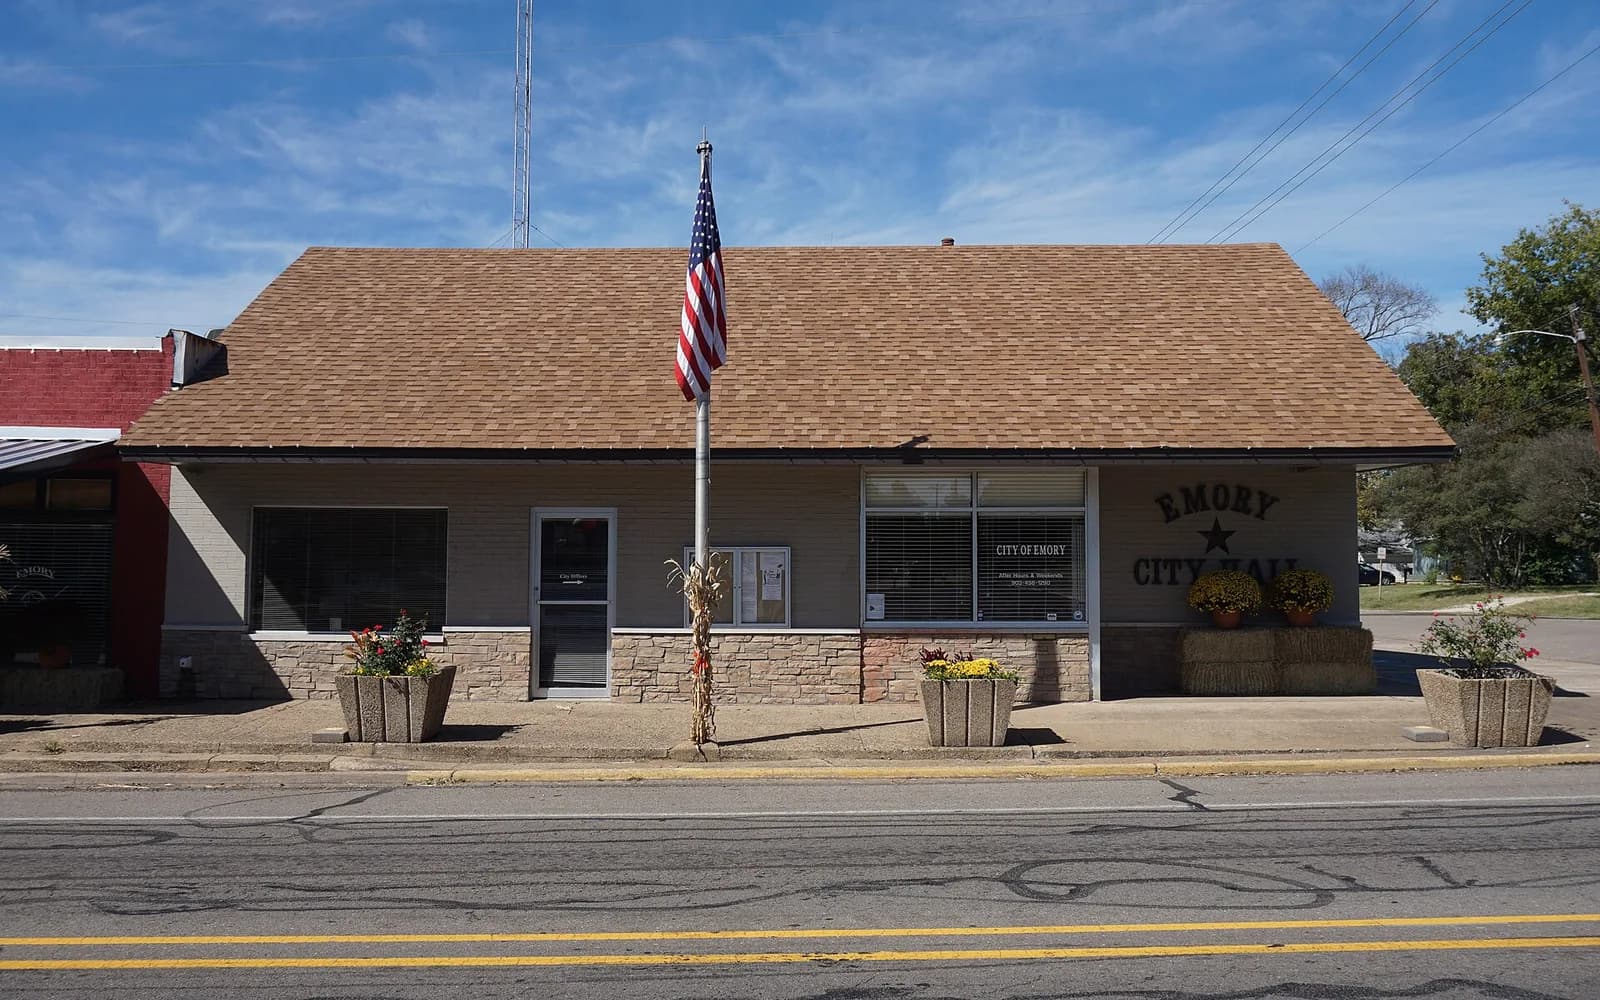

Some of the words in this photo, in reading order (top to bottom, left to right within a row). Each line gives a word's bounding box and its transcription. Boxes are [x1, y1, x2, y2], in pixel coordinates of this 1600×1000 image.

[1155, 482, 1280, 524] EMORY
[996, 544, 1018, 556] CITY
[1020, 544, 1032, 556] OF
[1033, 544, 1066, 556] EMORY
[1133, 557, 1206, 586] CITY
